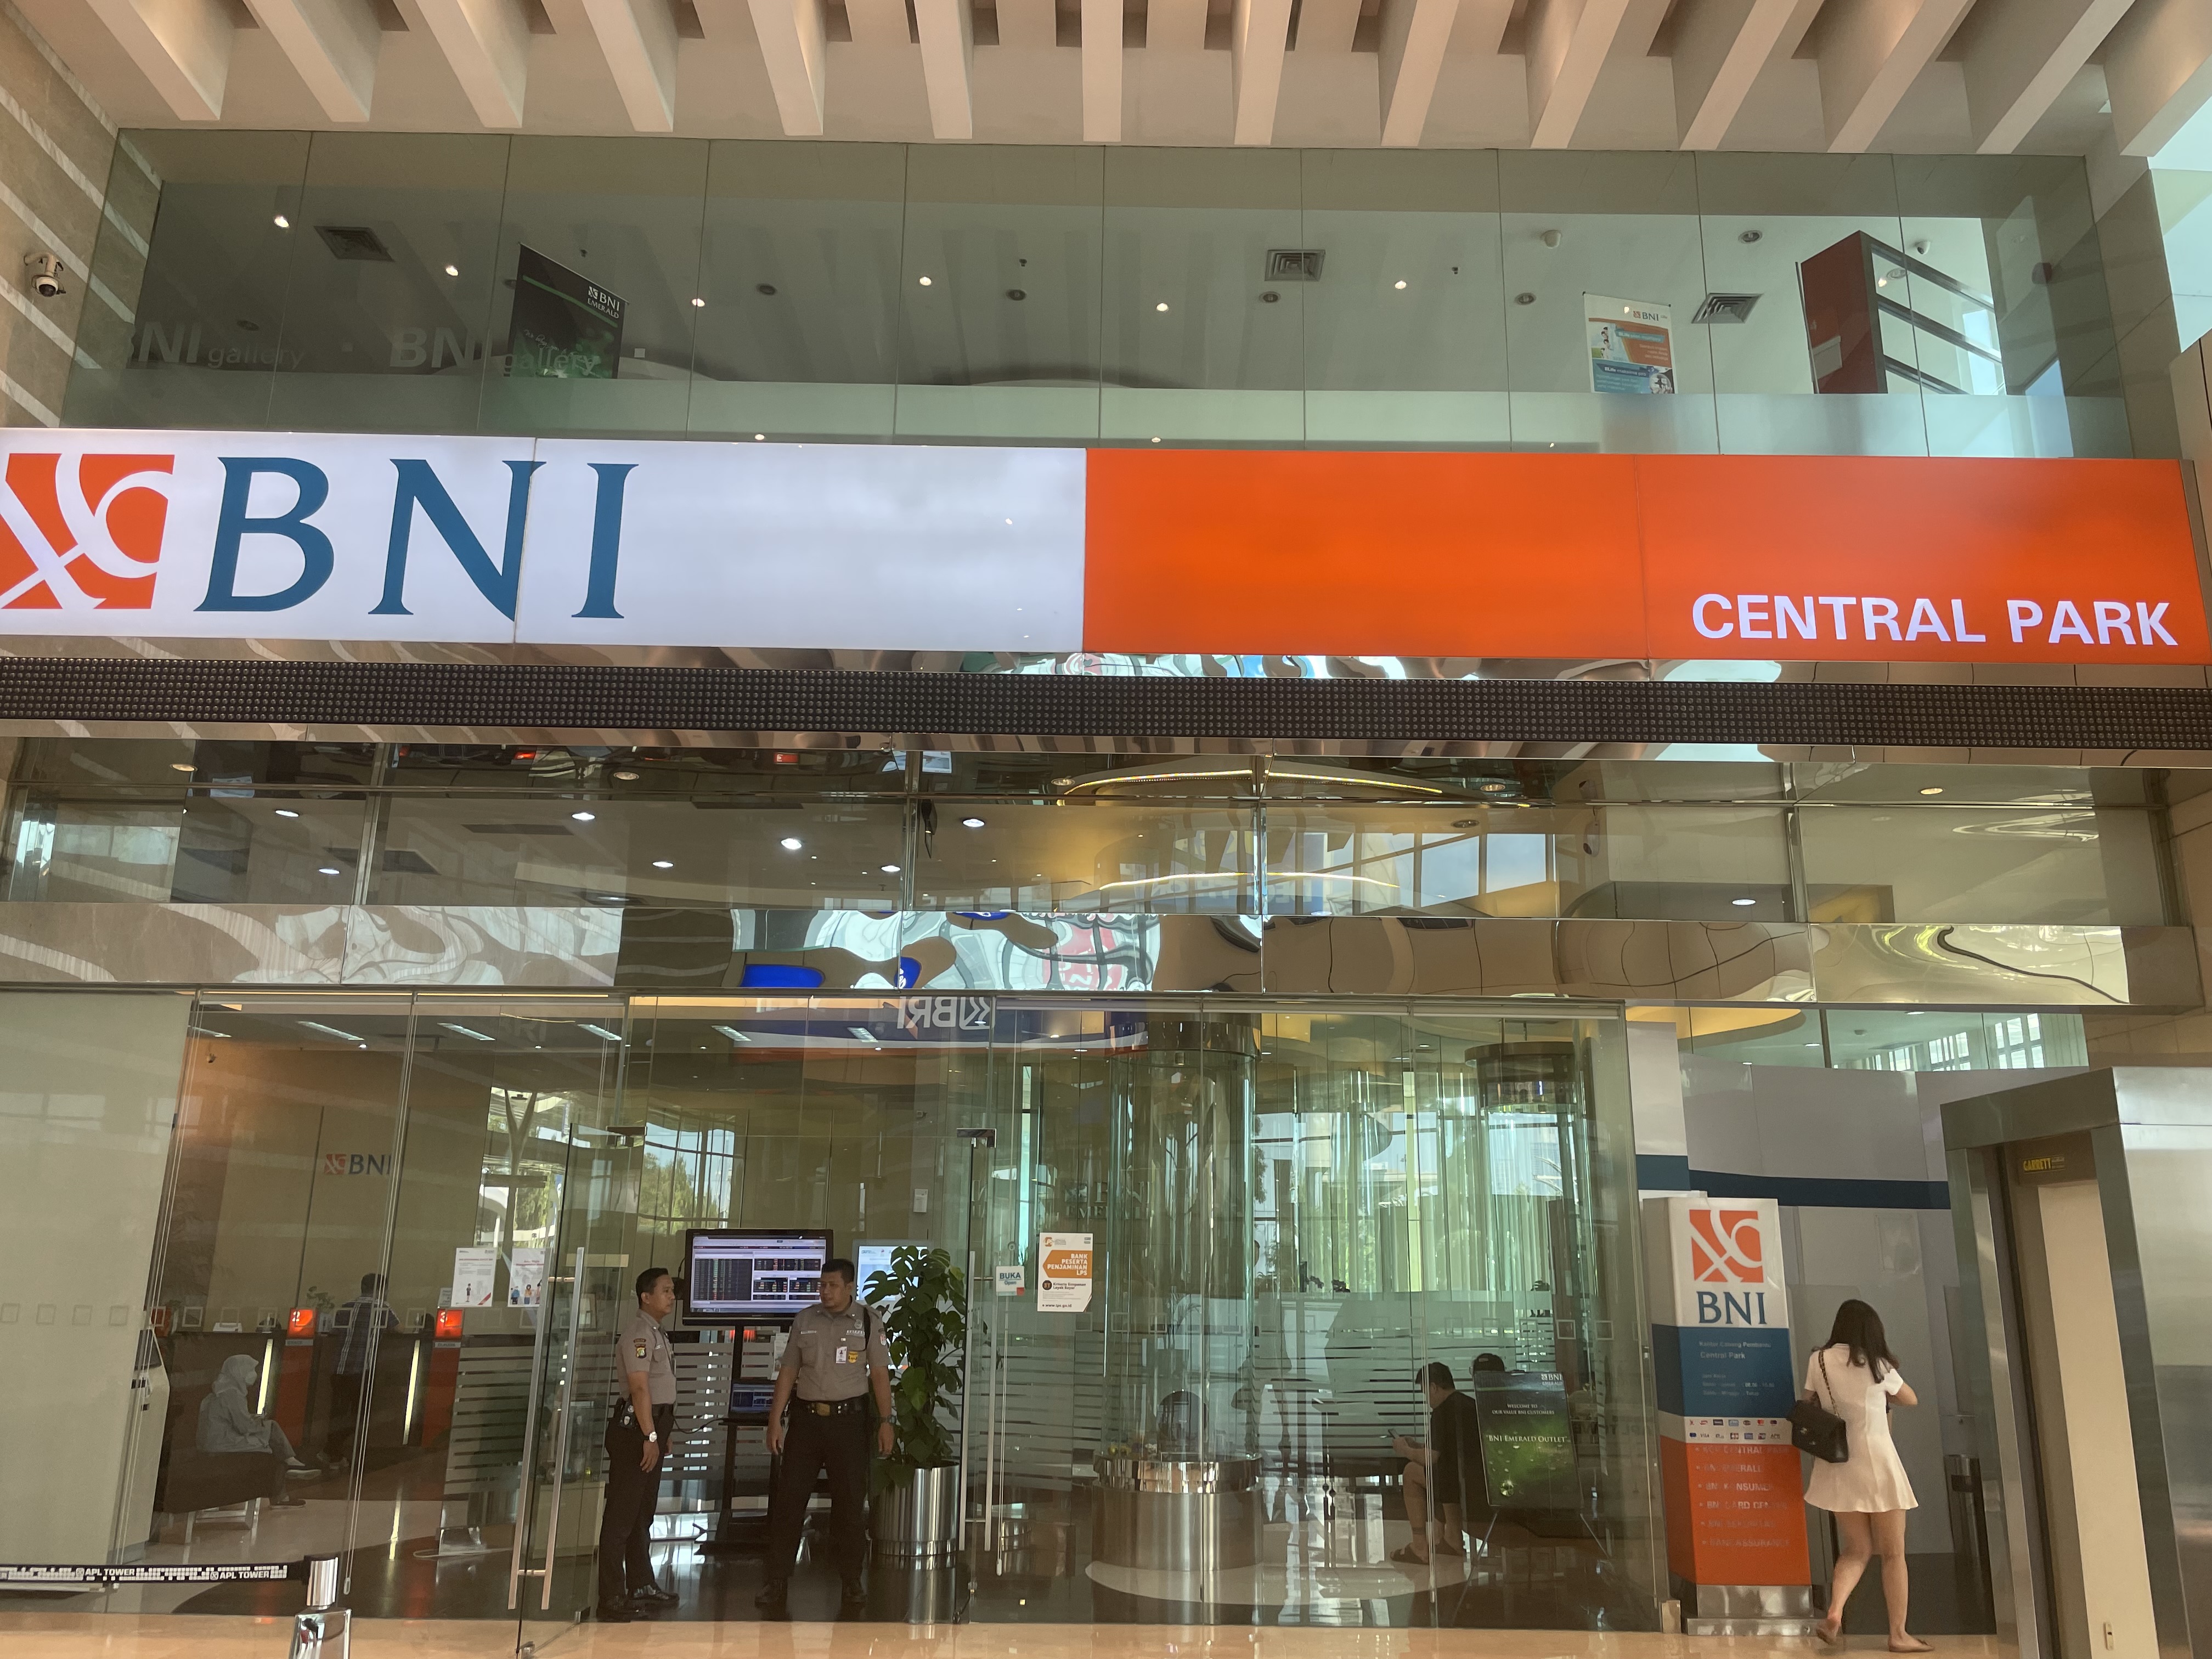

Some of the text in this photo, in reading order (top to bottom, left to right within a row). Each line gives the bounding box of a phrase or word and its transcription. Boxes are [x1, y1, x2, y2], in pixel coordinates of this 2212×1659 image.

[588, 298, 619, 319] EMERALD
[600, 292, 620, 311] BNI
[1642, 312, 1659, 321] BNI
[131, 320, 305, 369] NI gallery
[193, 457, 639, 622] BNI
[1692, 593, 2178, 646] CENTRAL PARK
[348, 1154, 392, 1175] BNI
[292, 1311, 301, 1322] 2
[1696, 1291, 1767, 1325] BNI
[1724, 1483, 1774, 1491] KNSUMER
